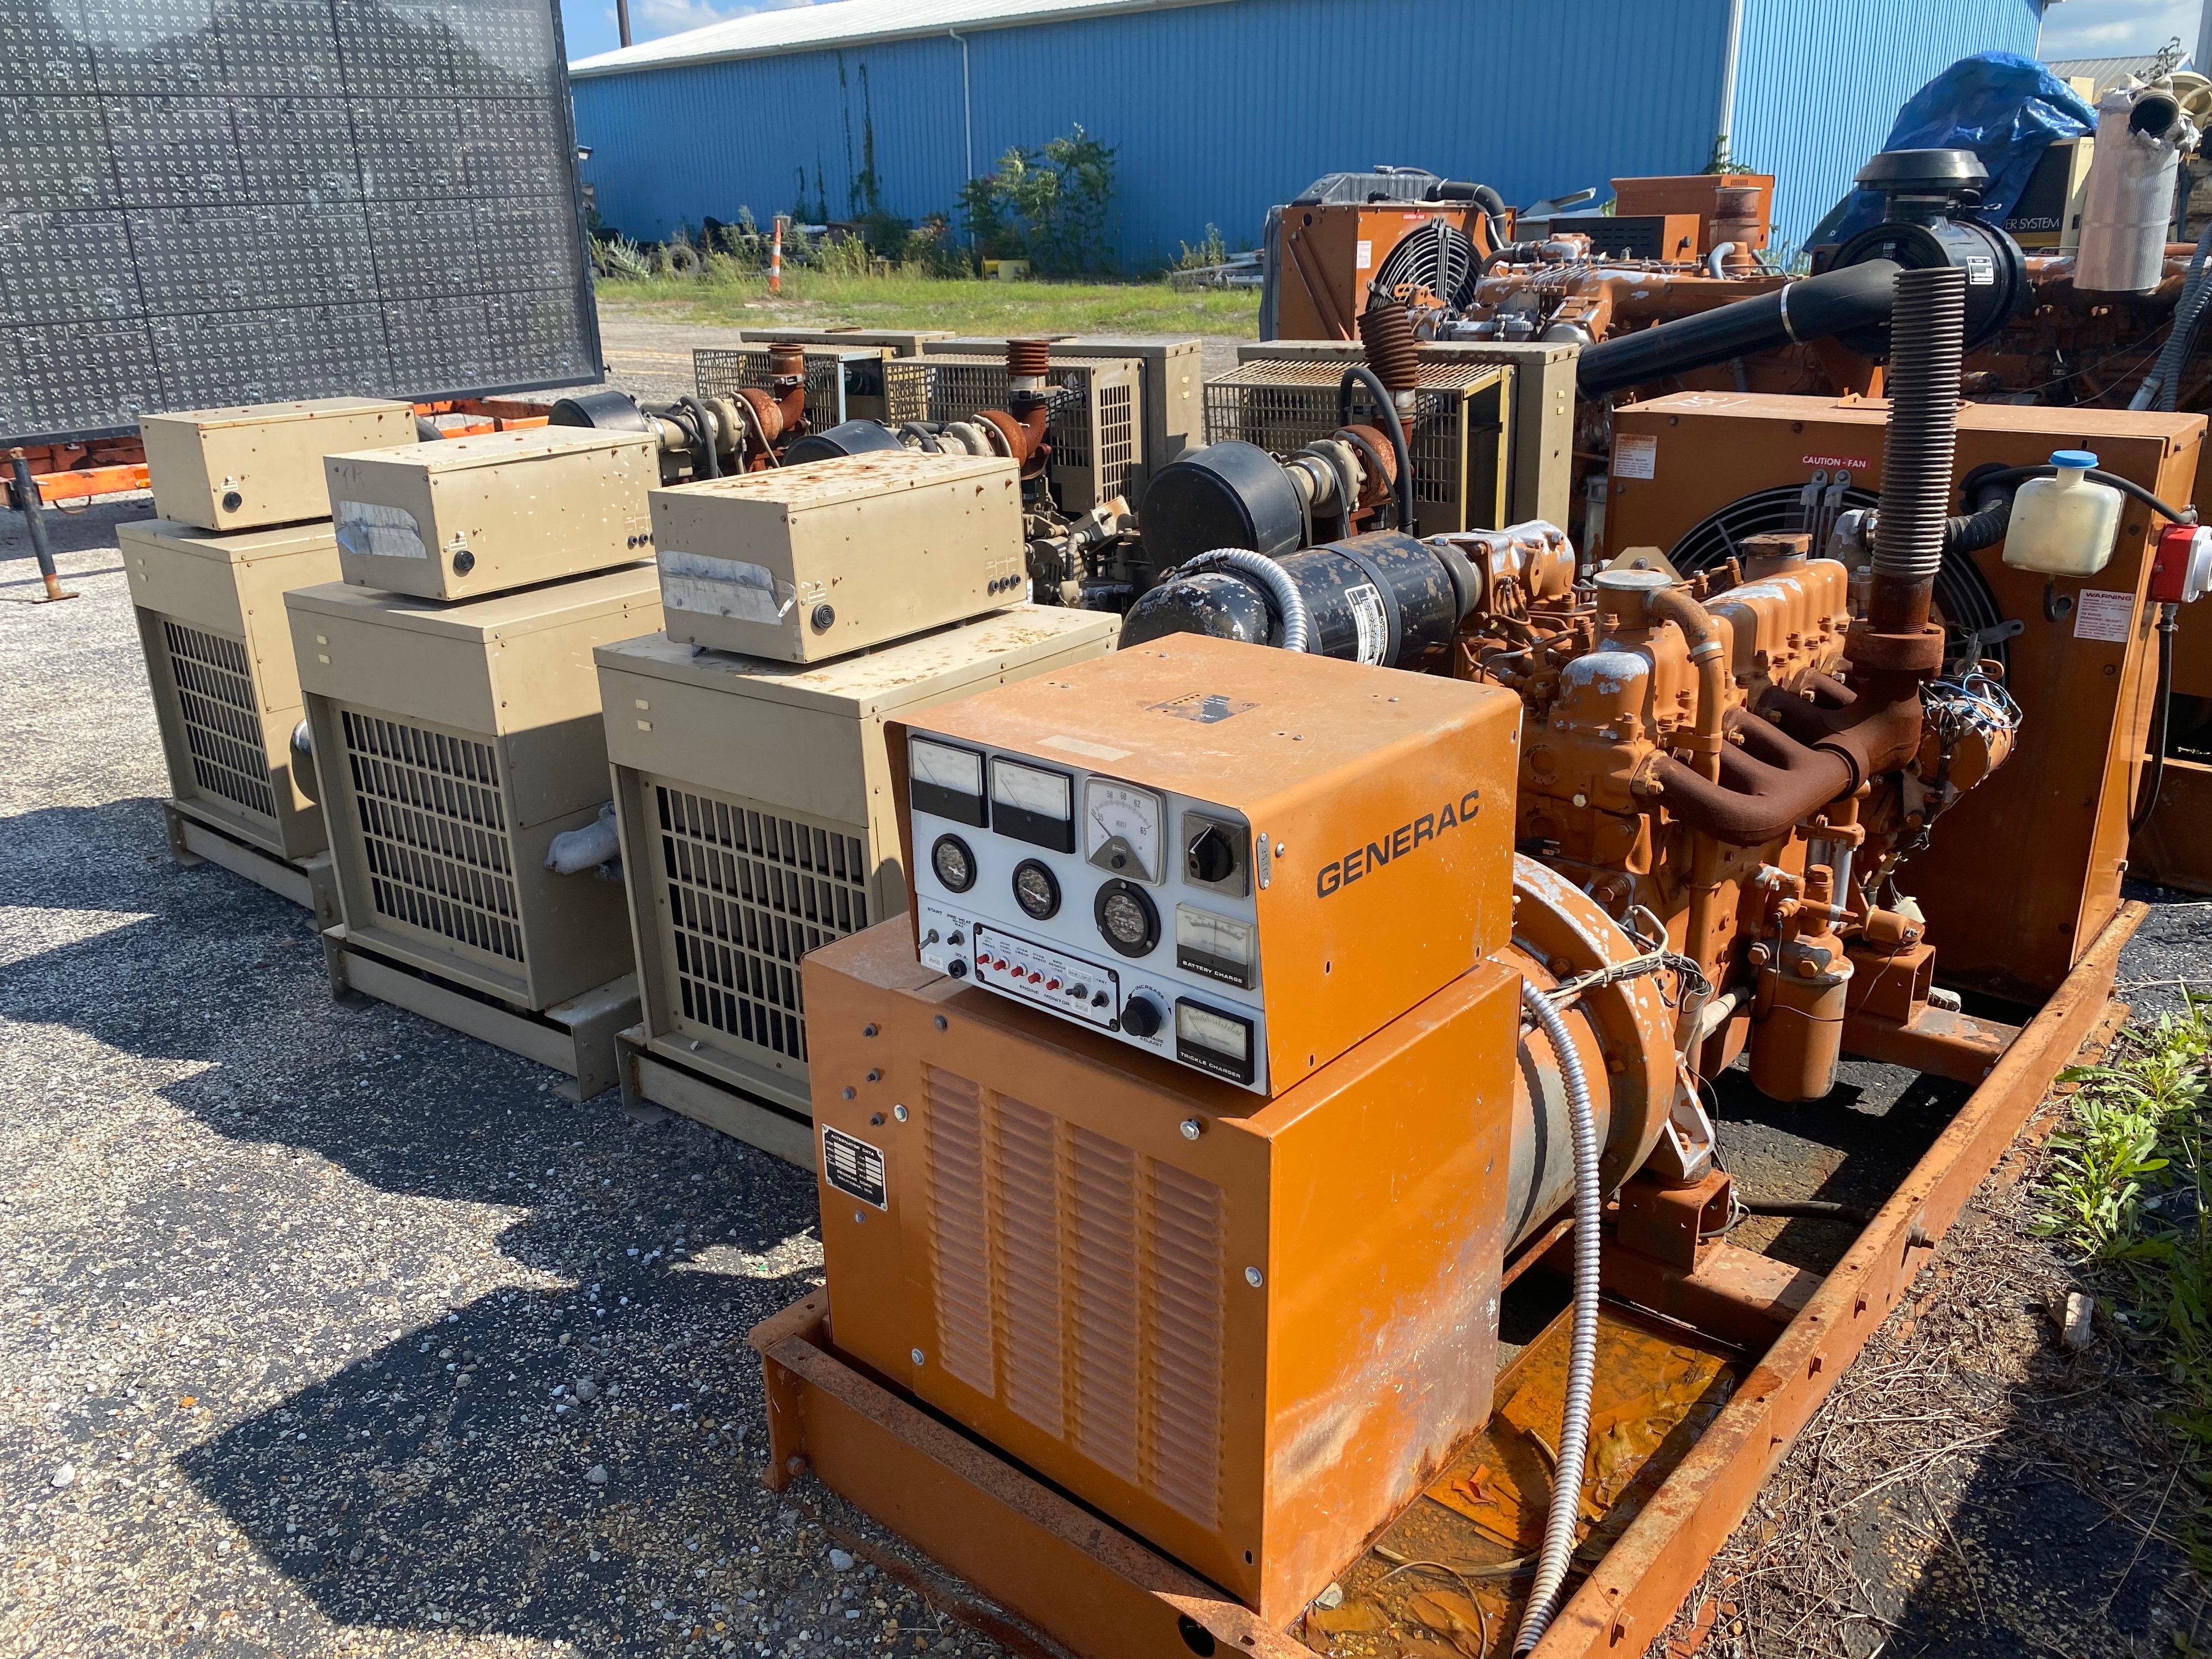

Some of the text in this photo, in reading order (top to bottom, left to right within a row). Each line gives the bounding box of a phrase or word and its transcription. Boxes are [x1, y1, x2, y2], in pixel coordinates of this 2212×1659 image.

[2019, 217, 2060, 229] SYSTEM
[1802, 456, 1841, 466] CAUTION
[1847, 459, 1866, 468] FAN
[2086, 592, 2132, 601] WARNING
[1133, 799, 1141, 808] 62
[1140, 826, 1147, 836] 65
[1317, 789, 1480, 899] GENERAC
[927, 907, 943, 915] START
[947, 913, 972, 925] PRE-HEAT
[1182, 960, 1243, 984] BATTERY CHARGE
[1019, 984, 1070, 1006] ENGINE MONITOR
[1135, 985, 1165, 1000] INCREASE
[1139, 1036, 1163, 1047] ADJUST
[1180, 1051, 1242, 1079] TRICKLE CHARGER
[831, 1134, 874, 1156] ALTERNATOR DATA
